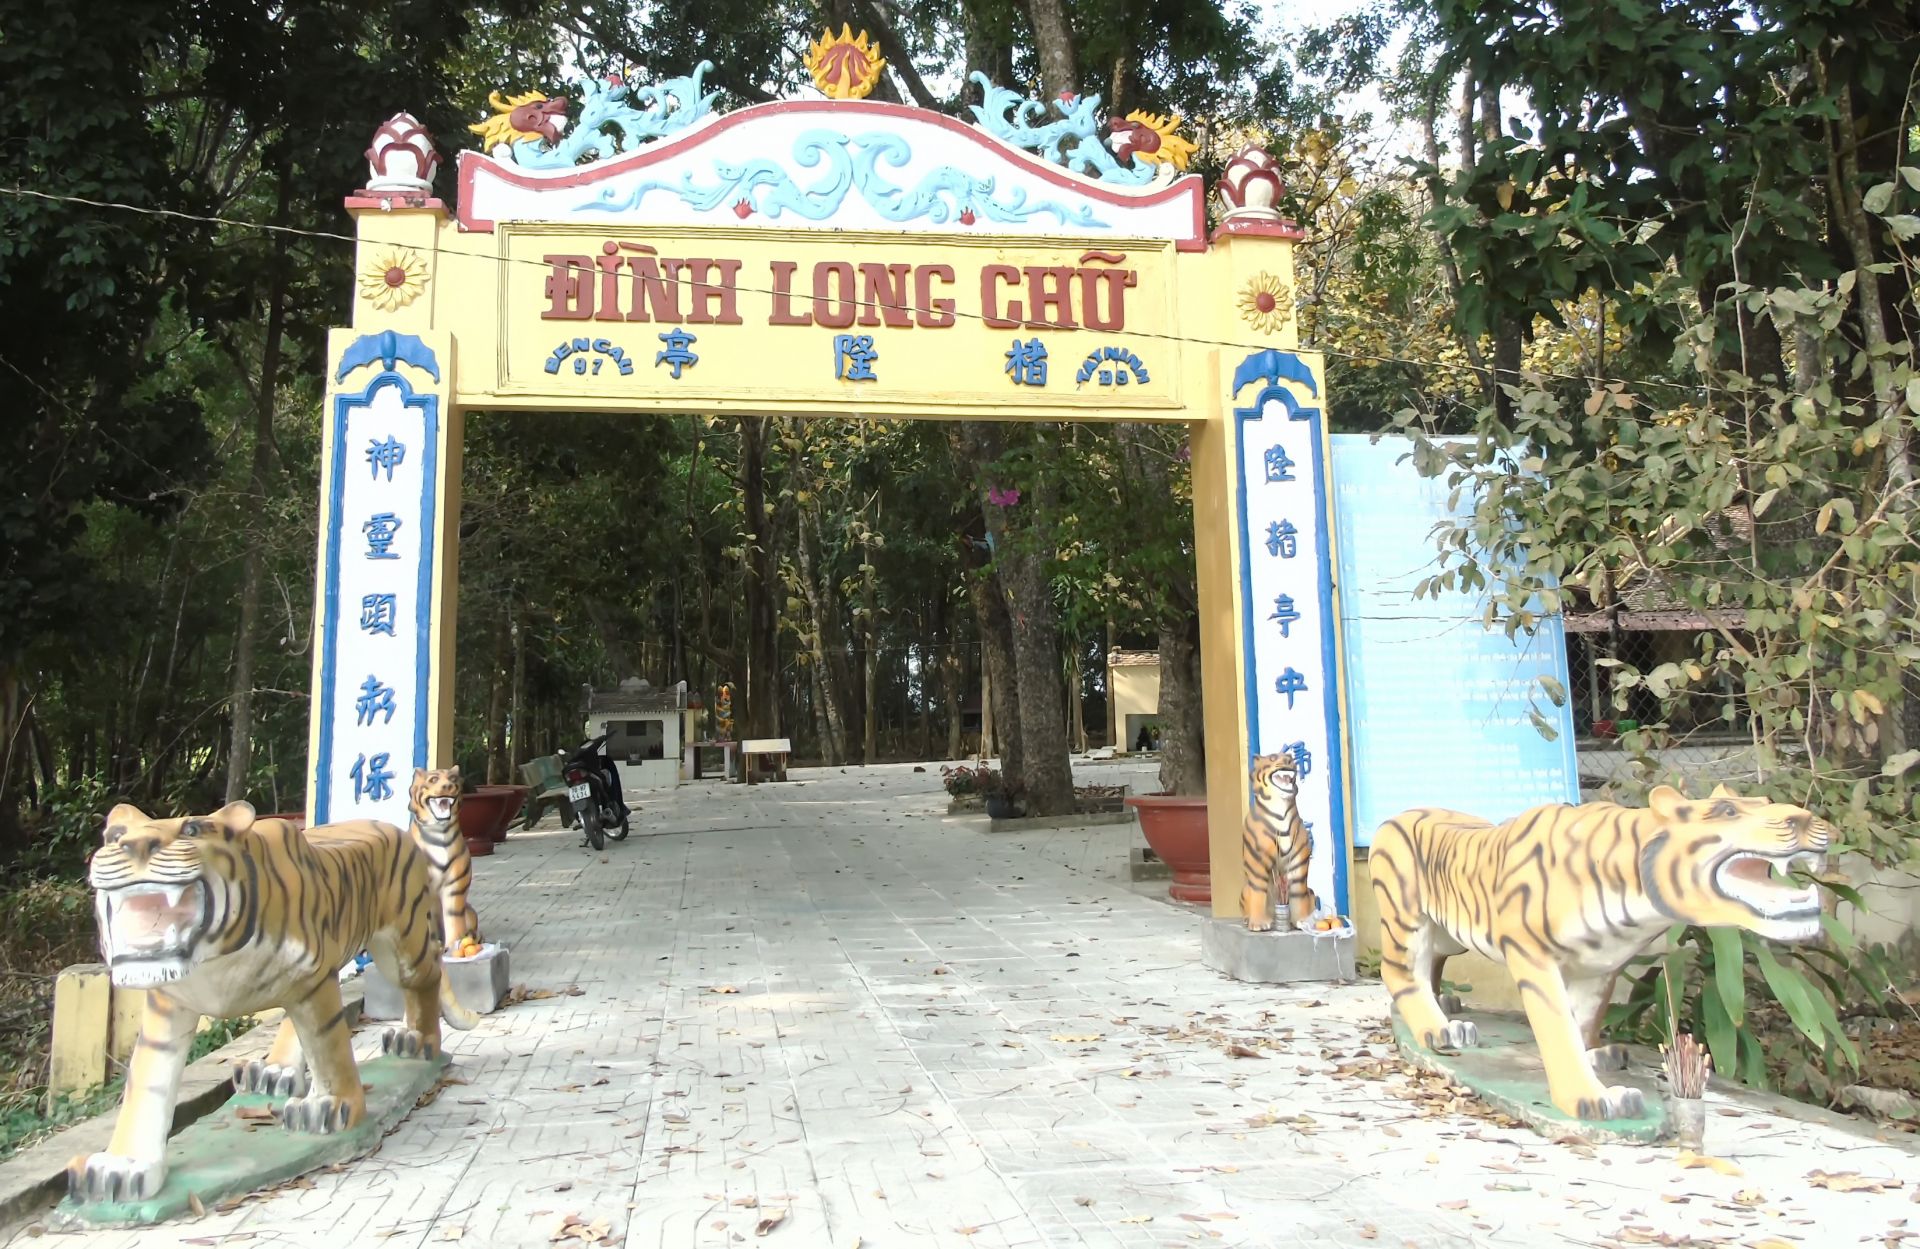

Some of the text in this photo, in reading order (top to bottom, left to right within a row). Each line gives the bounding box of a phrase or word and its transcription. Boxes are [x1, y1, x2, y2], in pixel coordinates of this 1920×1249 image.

[541, 241, 1137, 331] ĐÌNH LONG CHỮ
[573, 357, 603, 376] 97
[655, 328, 699, 379] 亭
[833, 334, 878, 381] 隆
